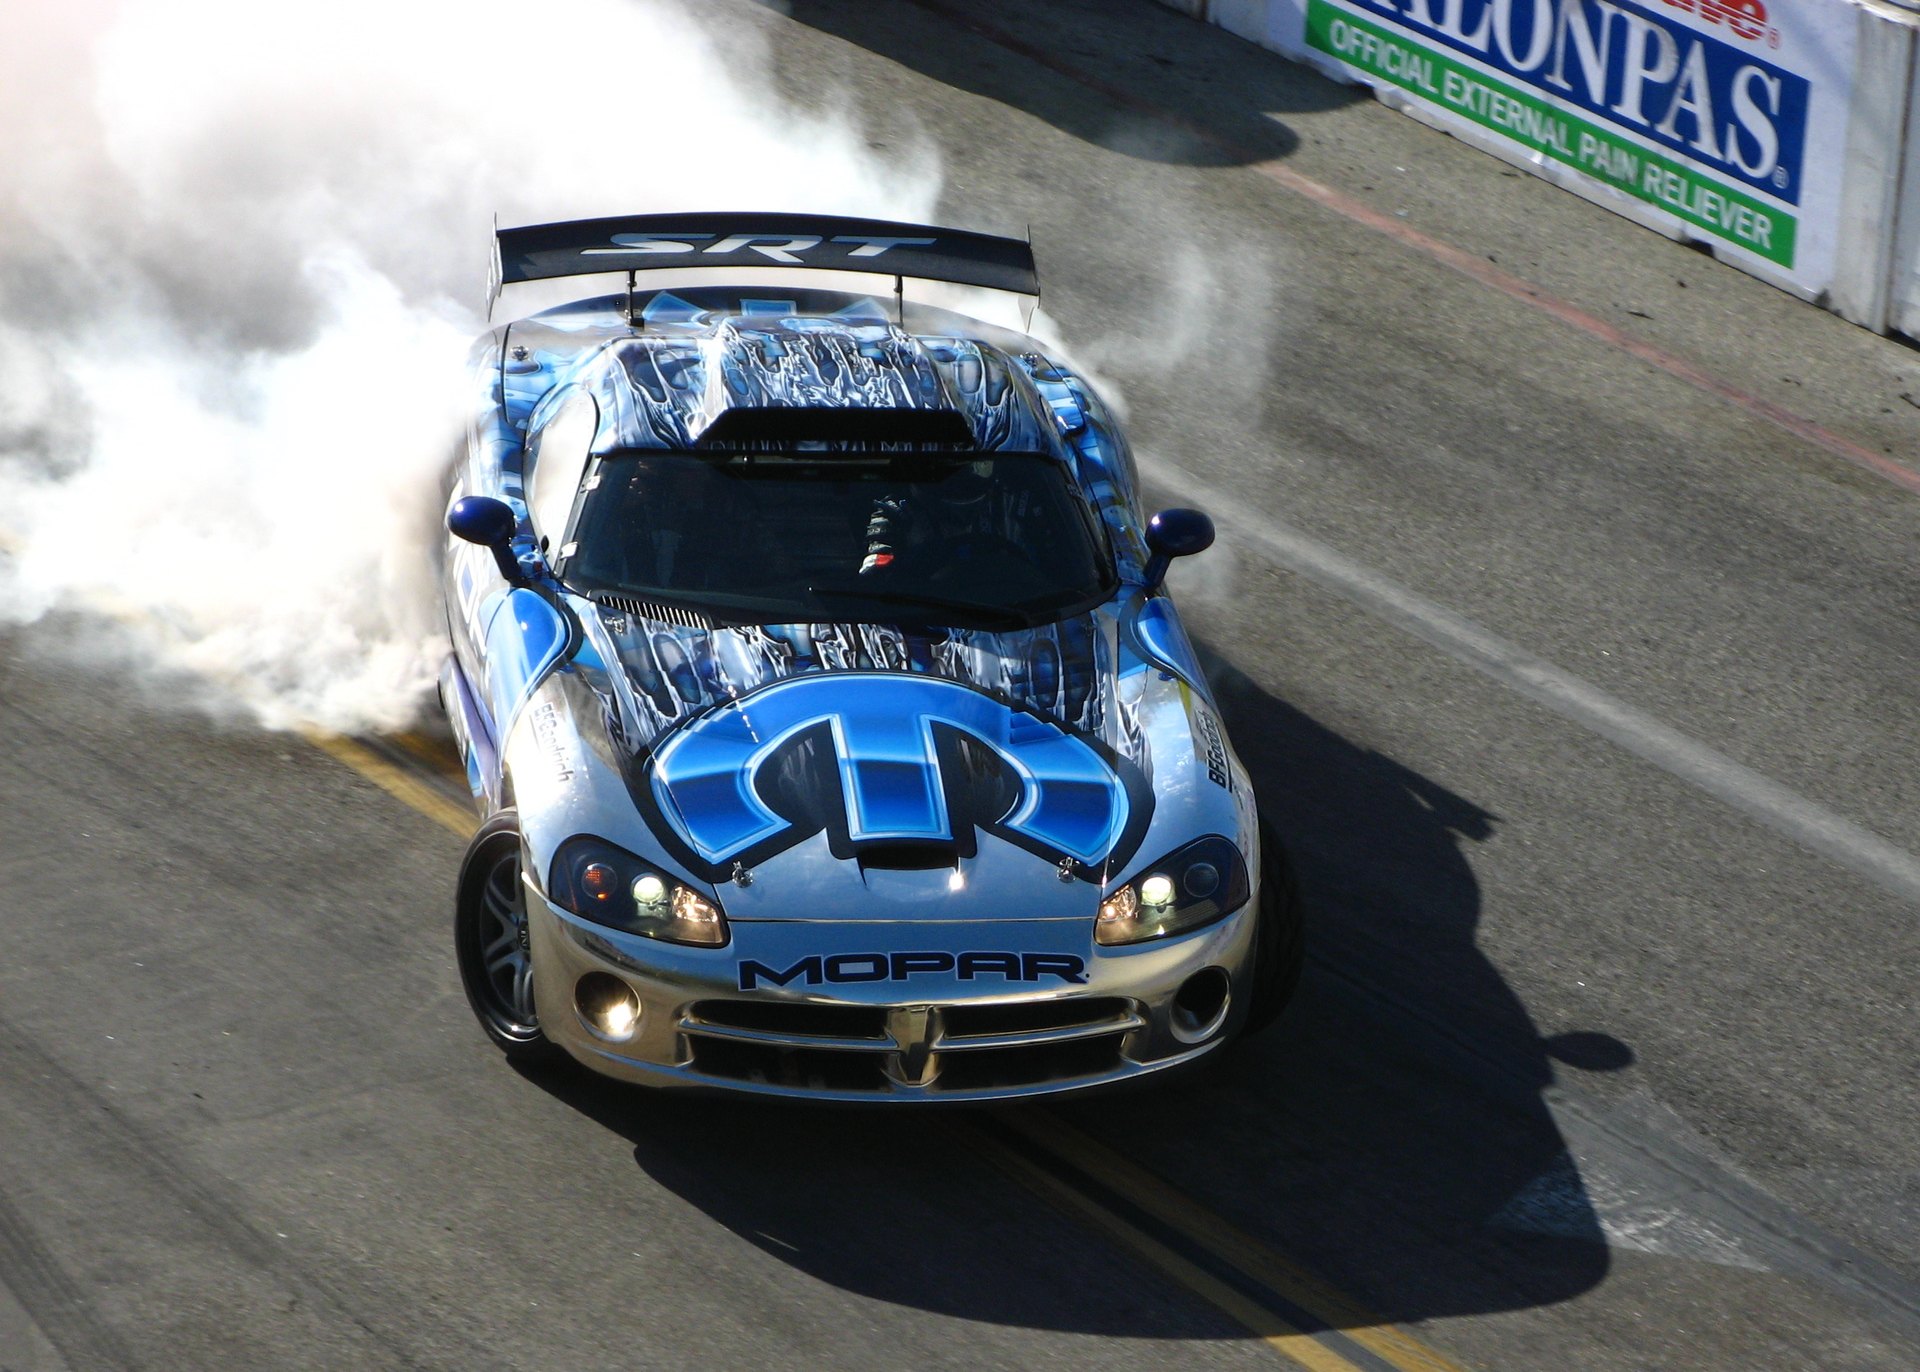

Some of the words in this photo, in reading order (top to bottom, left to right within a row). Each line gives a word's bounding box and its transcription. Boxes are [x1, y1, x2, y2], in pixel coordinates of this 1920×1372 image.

[1329, 19, 1438, 93] OFFICIAL
[1446, 70, 1573, 156] EXTERNAL
[1579, 136, 1639, 187] PAIN
[1643, 167, 1774, 249] RELIEVER
[581, 233, 938, 264] SRT
[737, 951, 1089, 991] MOPAR
